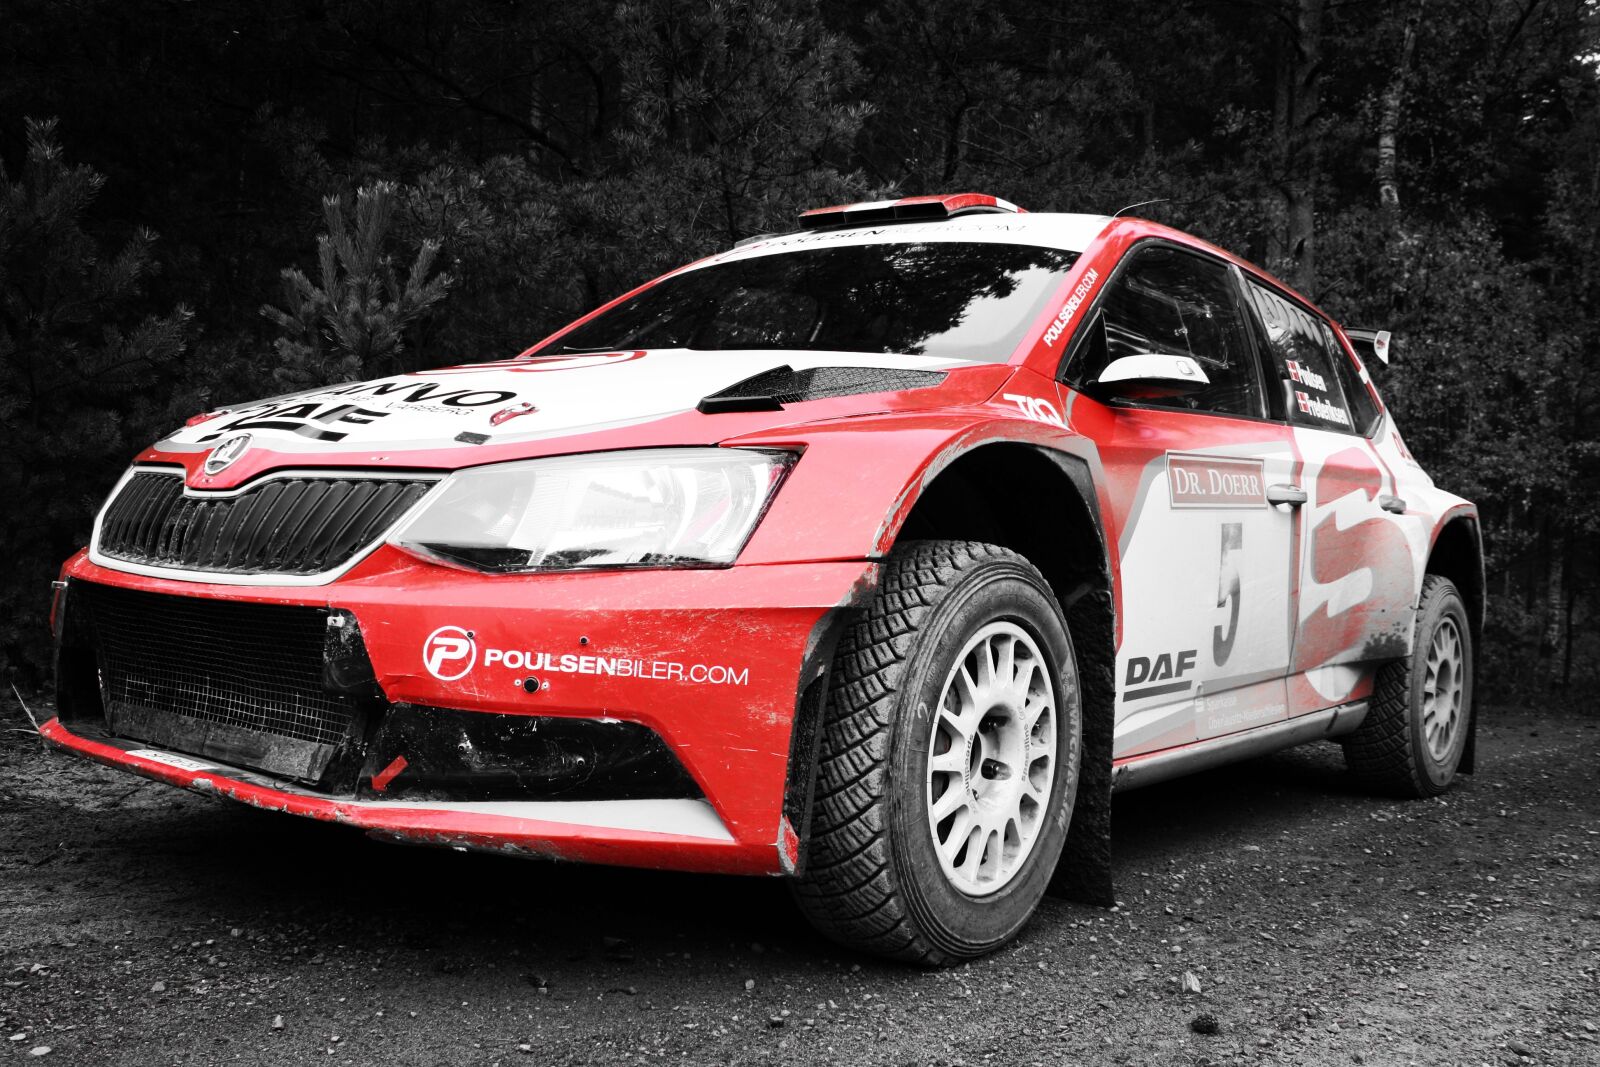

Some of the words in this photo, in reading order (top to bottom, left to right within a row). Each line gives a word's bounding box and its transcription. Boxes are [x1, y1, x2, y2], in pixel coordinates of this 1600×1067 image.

[1213, 523, 1243, 668] 5
[484, 648, 749, 686] POULSENBILER.COM
[1125, 650, 1197, 687] DAF
